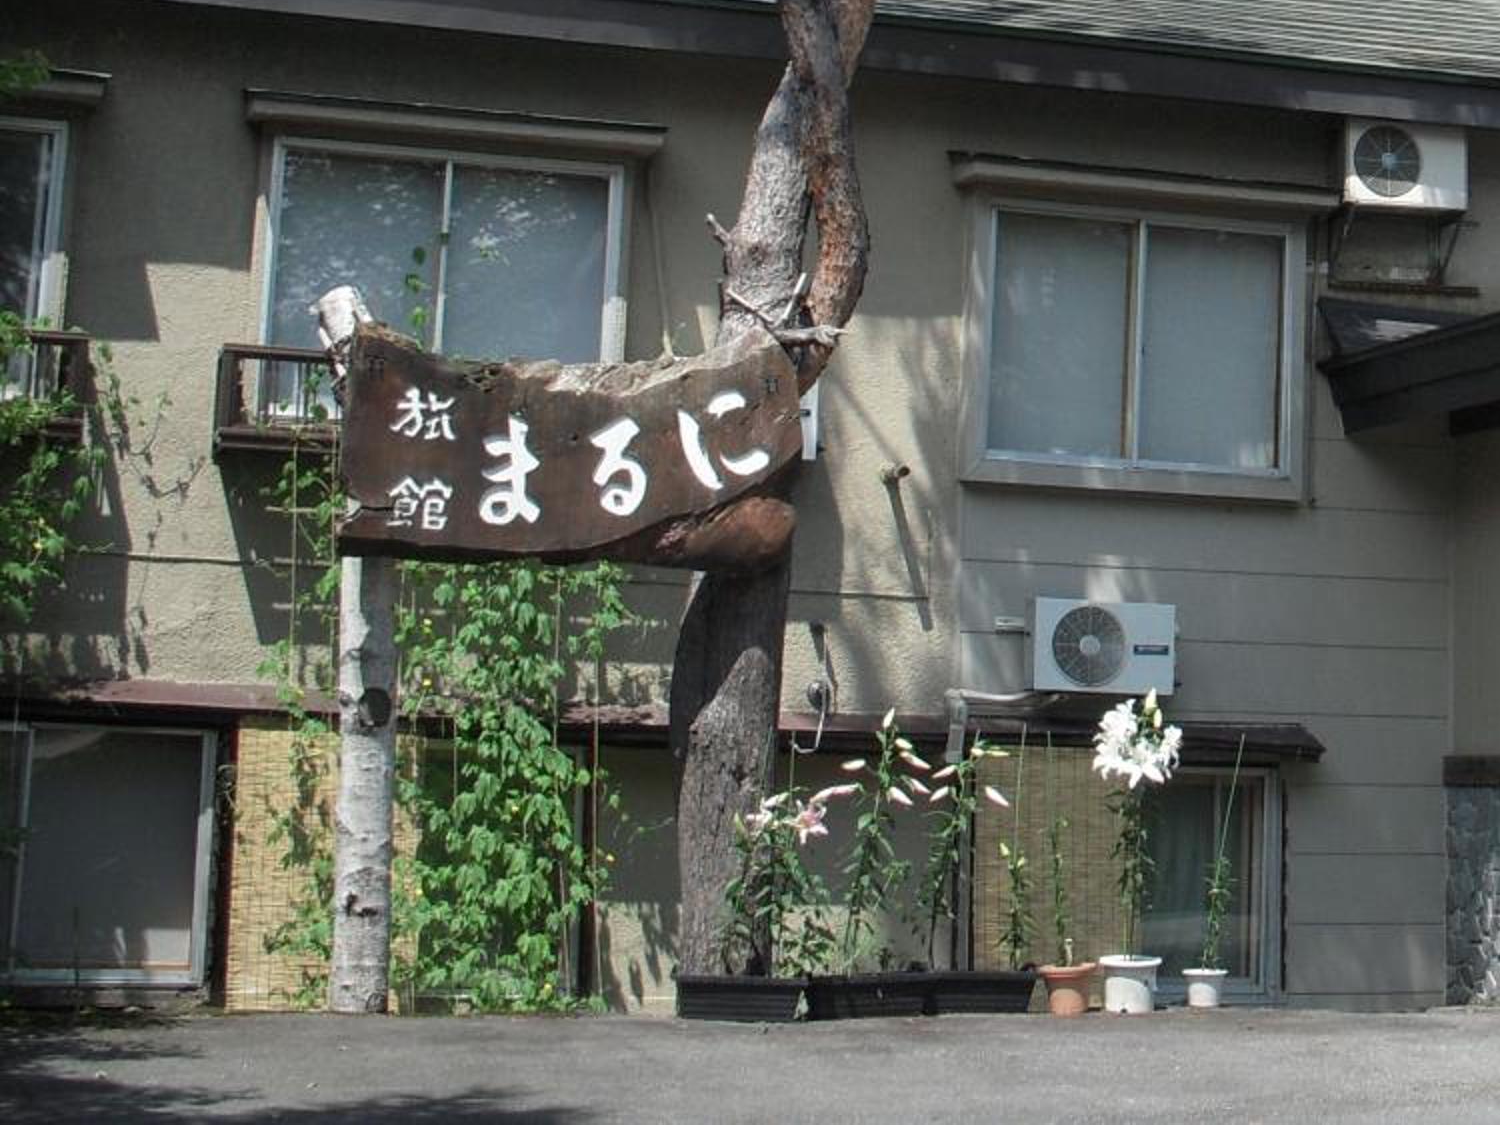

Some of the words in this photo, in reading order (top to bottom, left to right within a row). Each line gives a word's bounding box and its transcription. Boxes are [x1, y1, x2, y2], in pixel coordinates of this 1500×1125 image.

[387, 386, 456, 531] 旅館
[478, 390, 770, 526] まるに
